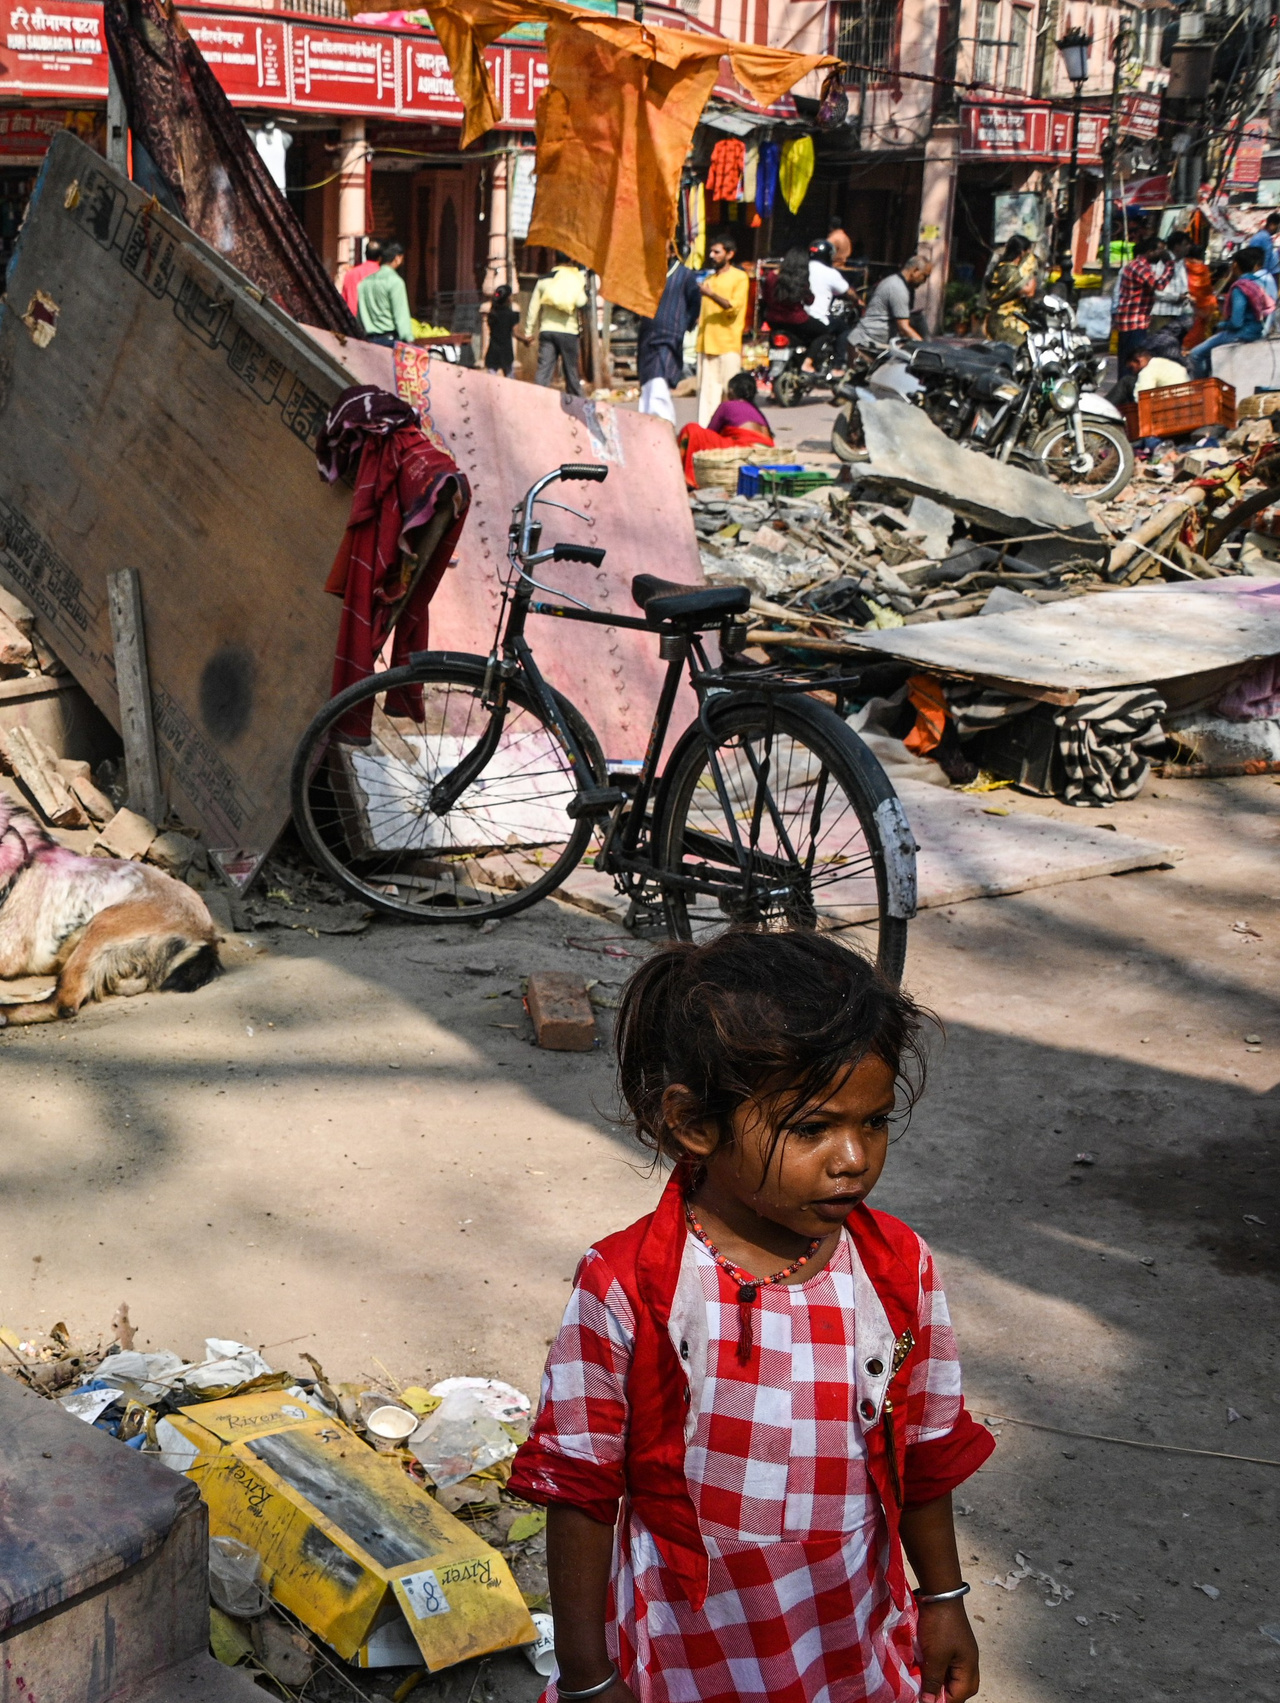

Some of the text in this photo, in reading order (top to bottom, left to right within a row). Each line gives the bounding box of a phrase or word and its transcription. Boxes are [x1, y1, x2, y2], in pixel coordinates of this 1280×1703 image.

[4, 512, 82, 597] THE KING OF PLY
[228, 1413, 282, 1429] River
[224, 1462, 274, 1508] River
[400, 1499, 454, 1546] River
[441, 1558, 493, 1586] River
